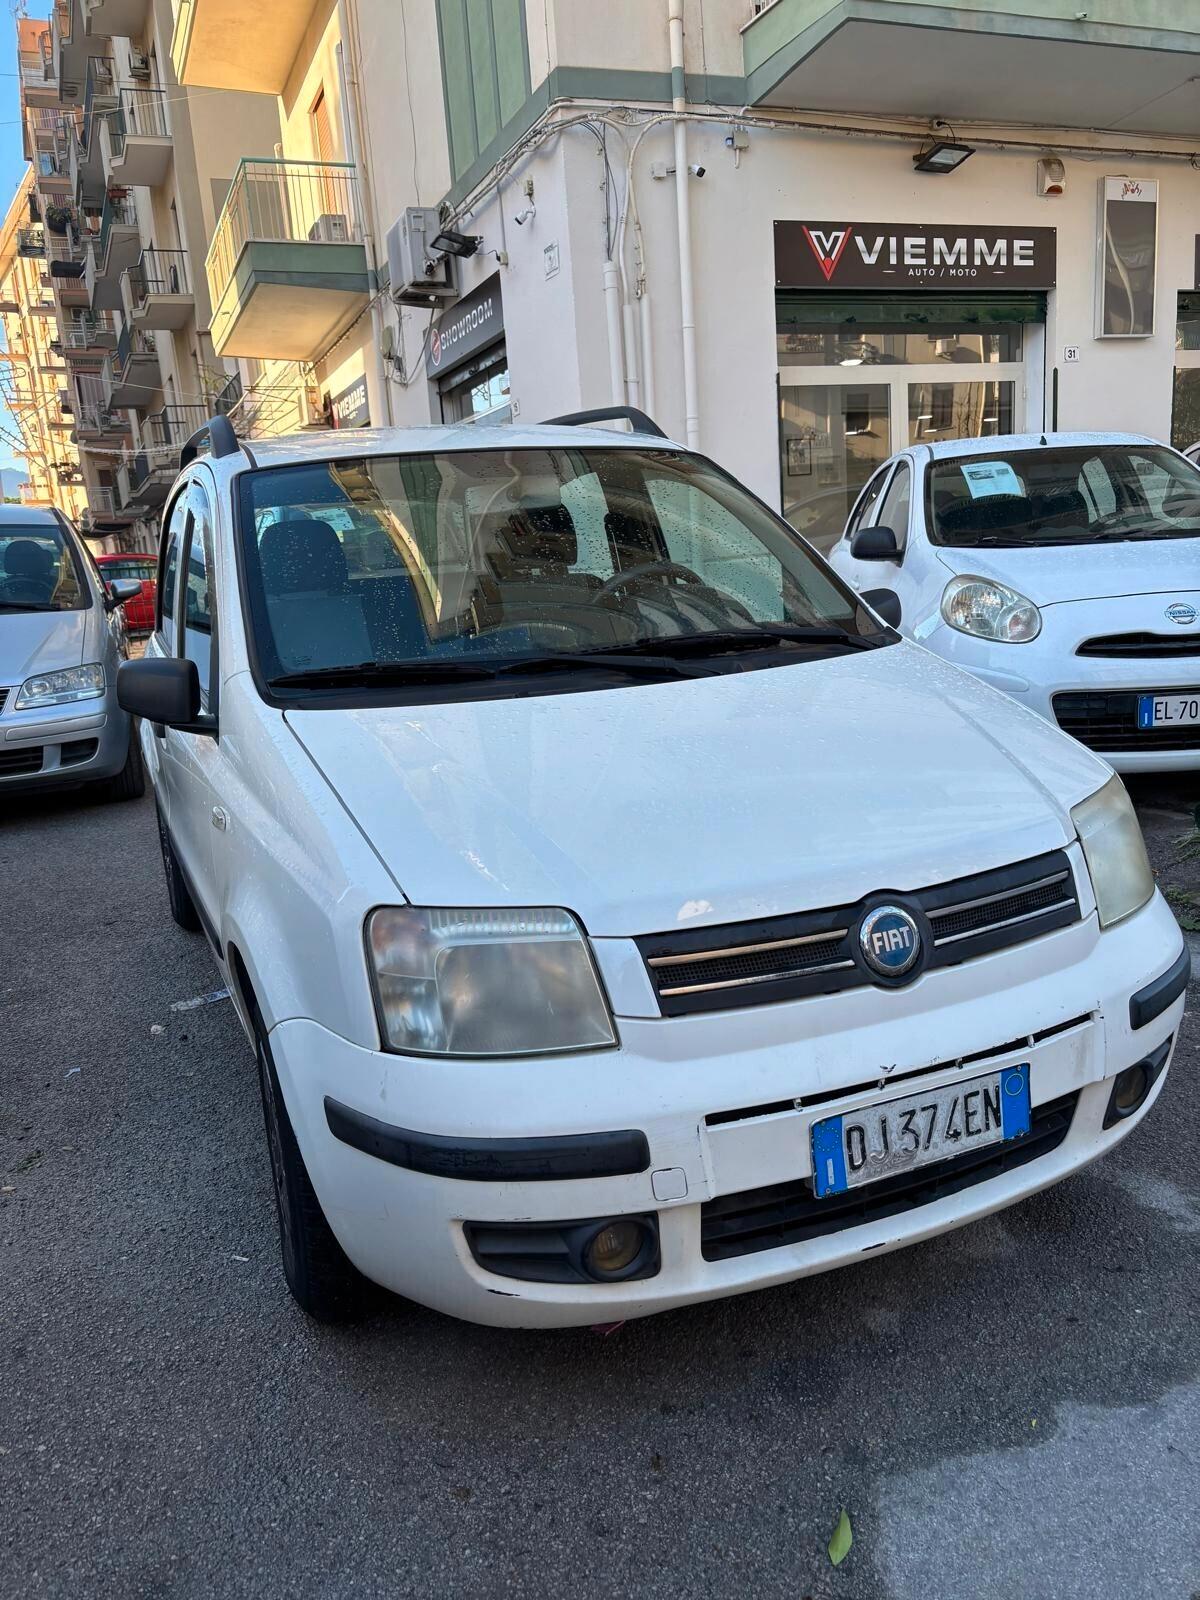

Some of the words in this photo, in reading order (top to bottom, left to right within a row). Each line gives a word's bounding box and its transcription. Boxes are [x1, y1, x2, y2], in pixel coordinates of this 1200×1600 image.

[855, 236, 1035, 266] VIEMME
[908, 268, 935, 277] AUTO
[949, 268, 977, 277] MOTO
[440, 297, 493, 350] SHOWROOM
[1067, 349, 1076, 359] 31
[1168, 609, 1197, 617] NISSAN
[871, 925, 910, 955] FIAT
